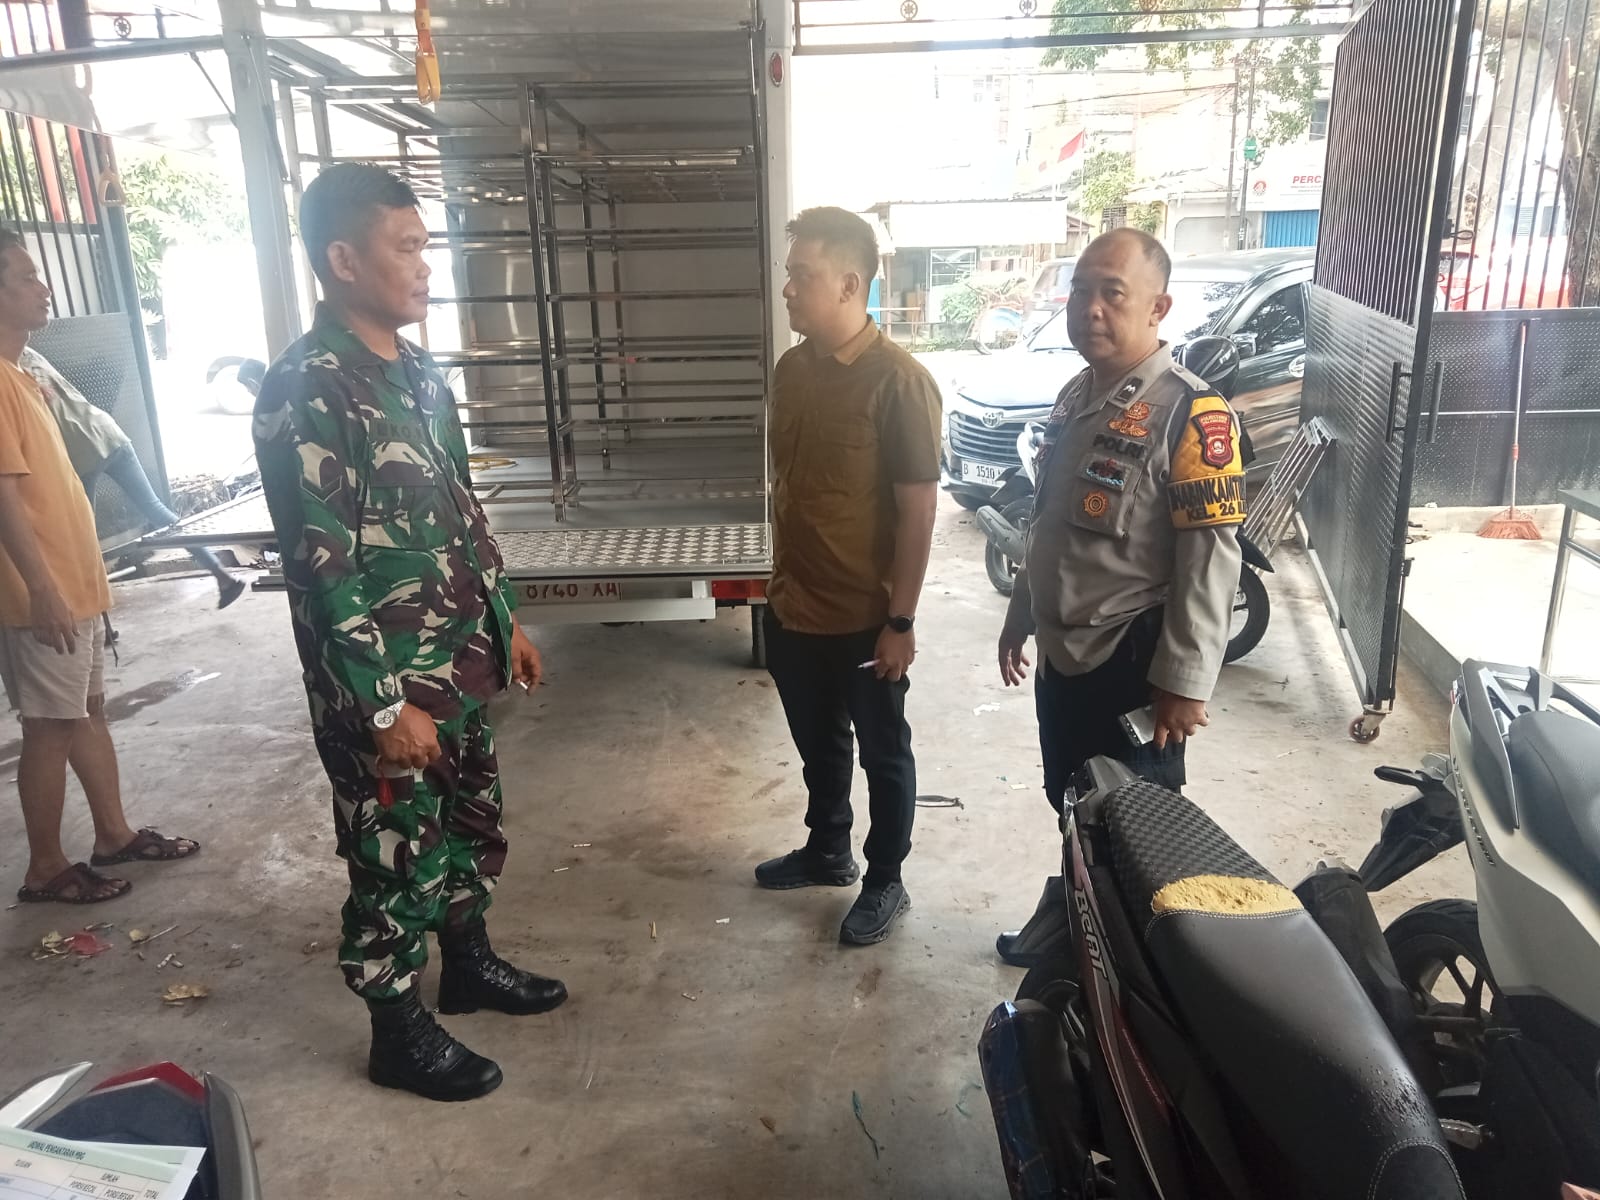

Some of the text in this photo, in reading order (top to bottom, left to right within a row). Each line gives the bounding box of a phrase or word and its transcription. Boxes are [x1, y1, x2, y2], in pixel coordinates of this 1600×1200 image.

[1292, 175, 1322, 184] PERC
[963, 463, 995, 480] B 1510
[1219, 502, 1235, 516] 26
